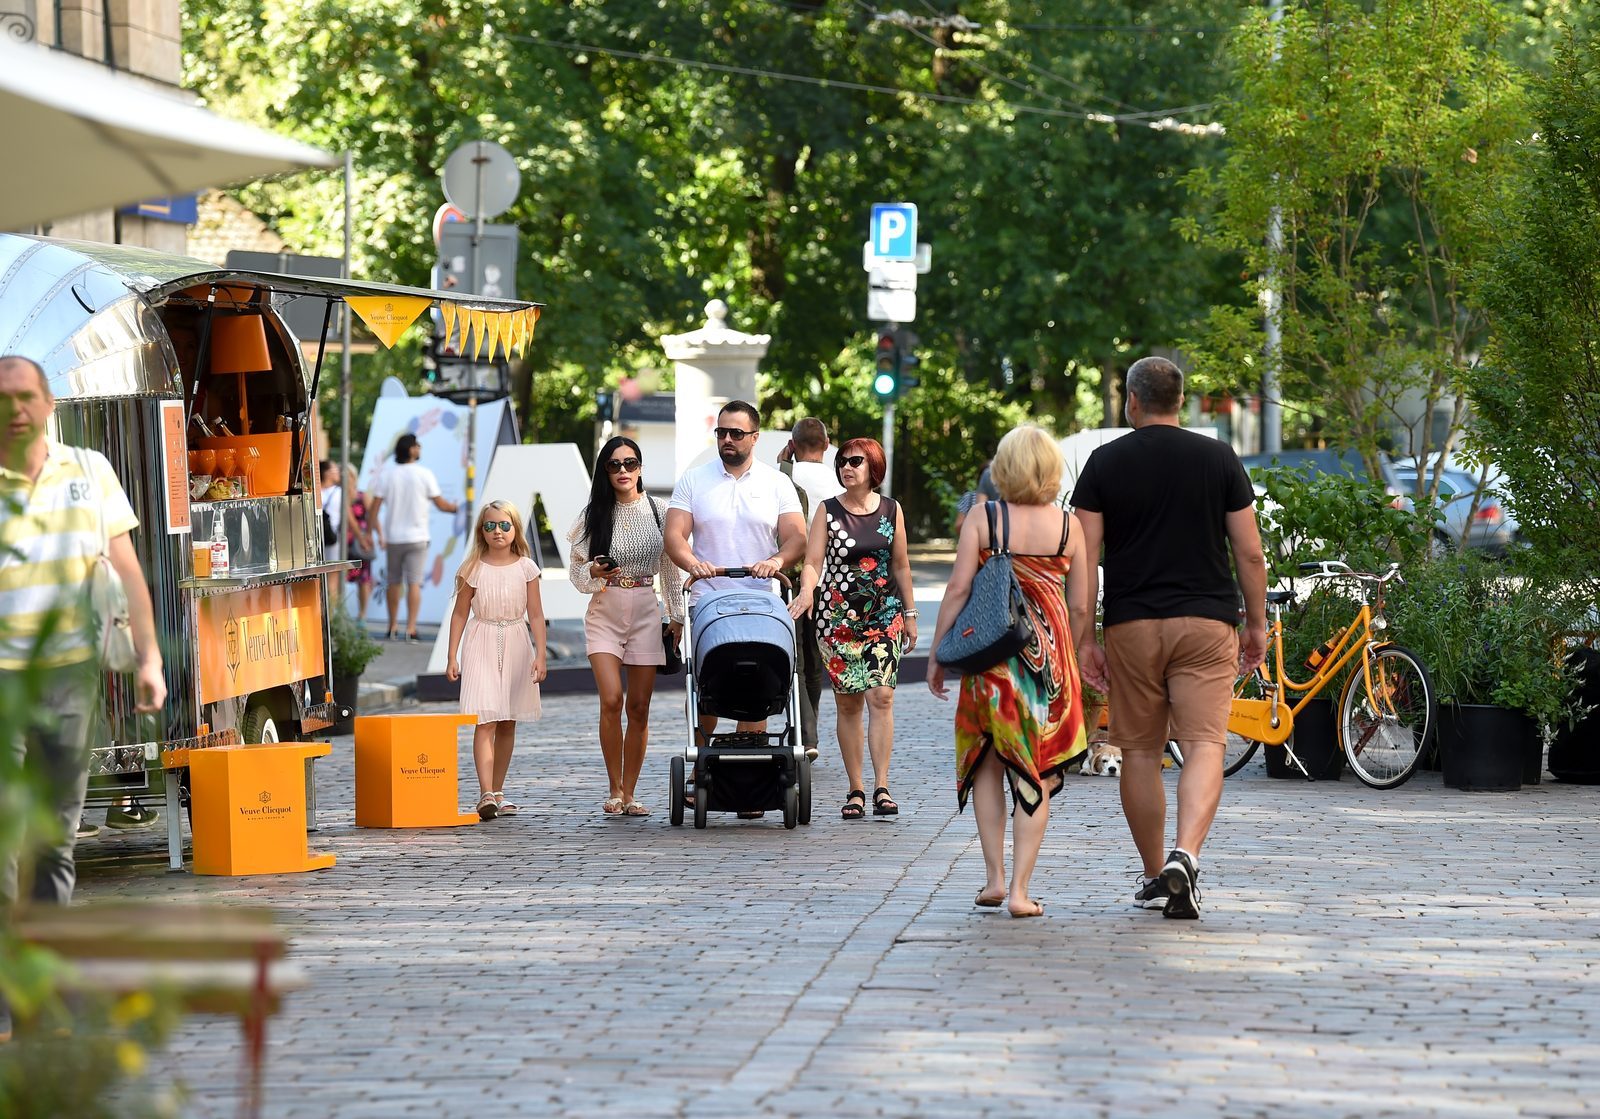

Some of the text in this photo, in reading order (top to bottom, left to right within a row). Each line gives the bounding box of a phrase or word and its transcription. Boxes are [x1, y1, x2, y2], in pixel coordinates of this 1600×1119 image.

[880, 210, 907, 254] P
[242, 615, 299, 665] Veuve Clicquot
[419, 766, 446, 775] Clicquot
[240, 806, 291, 815] Veuve Clicquot
